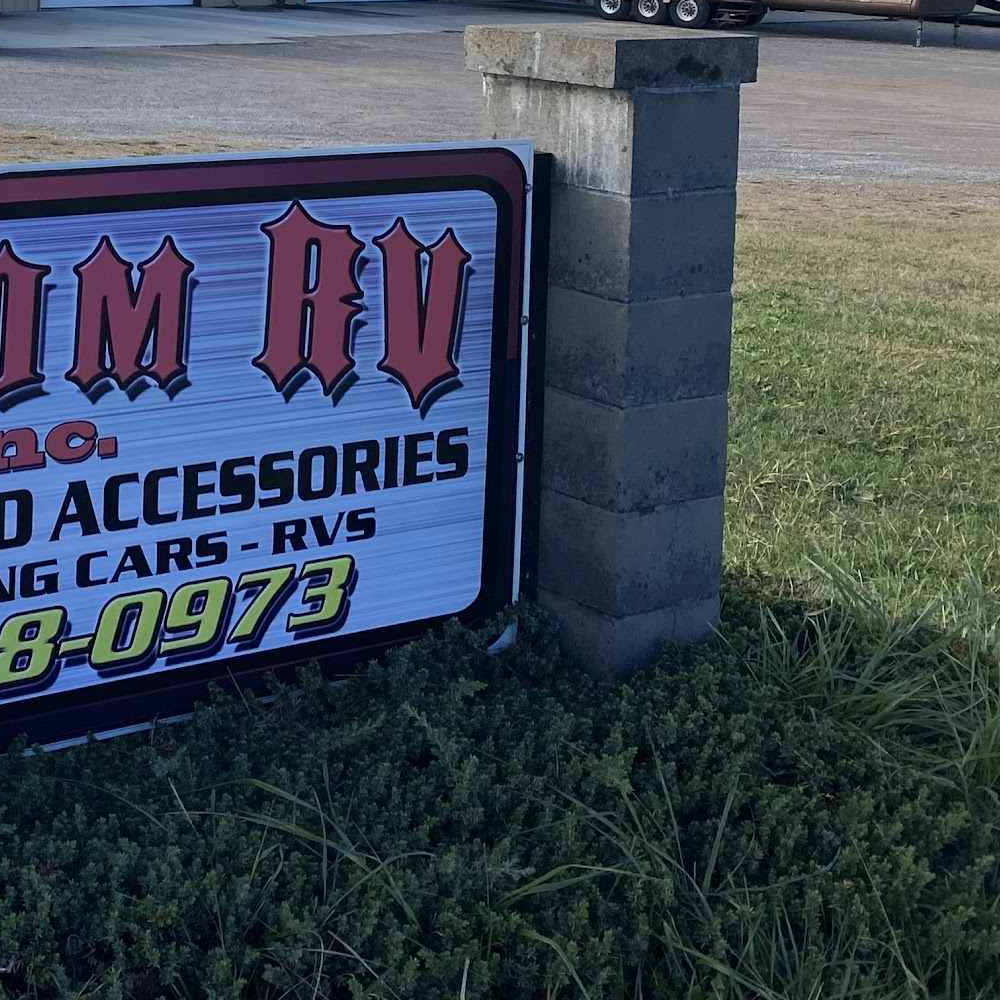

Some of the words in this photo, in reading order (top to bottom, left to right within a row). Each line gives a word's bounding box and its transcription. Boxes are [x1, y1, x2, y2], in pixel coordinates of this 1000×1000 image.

[252, 200, 473, 411] RV
[49, 427, 469, 543] ACCESSORIES
[75, 531, 228, 589] CARS
[271, 508, 377, 556] RVS
